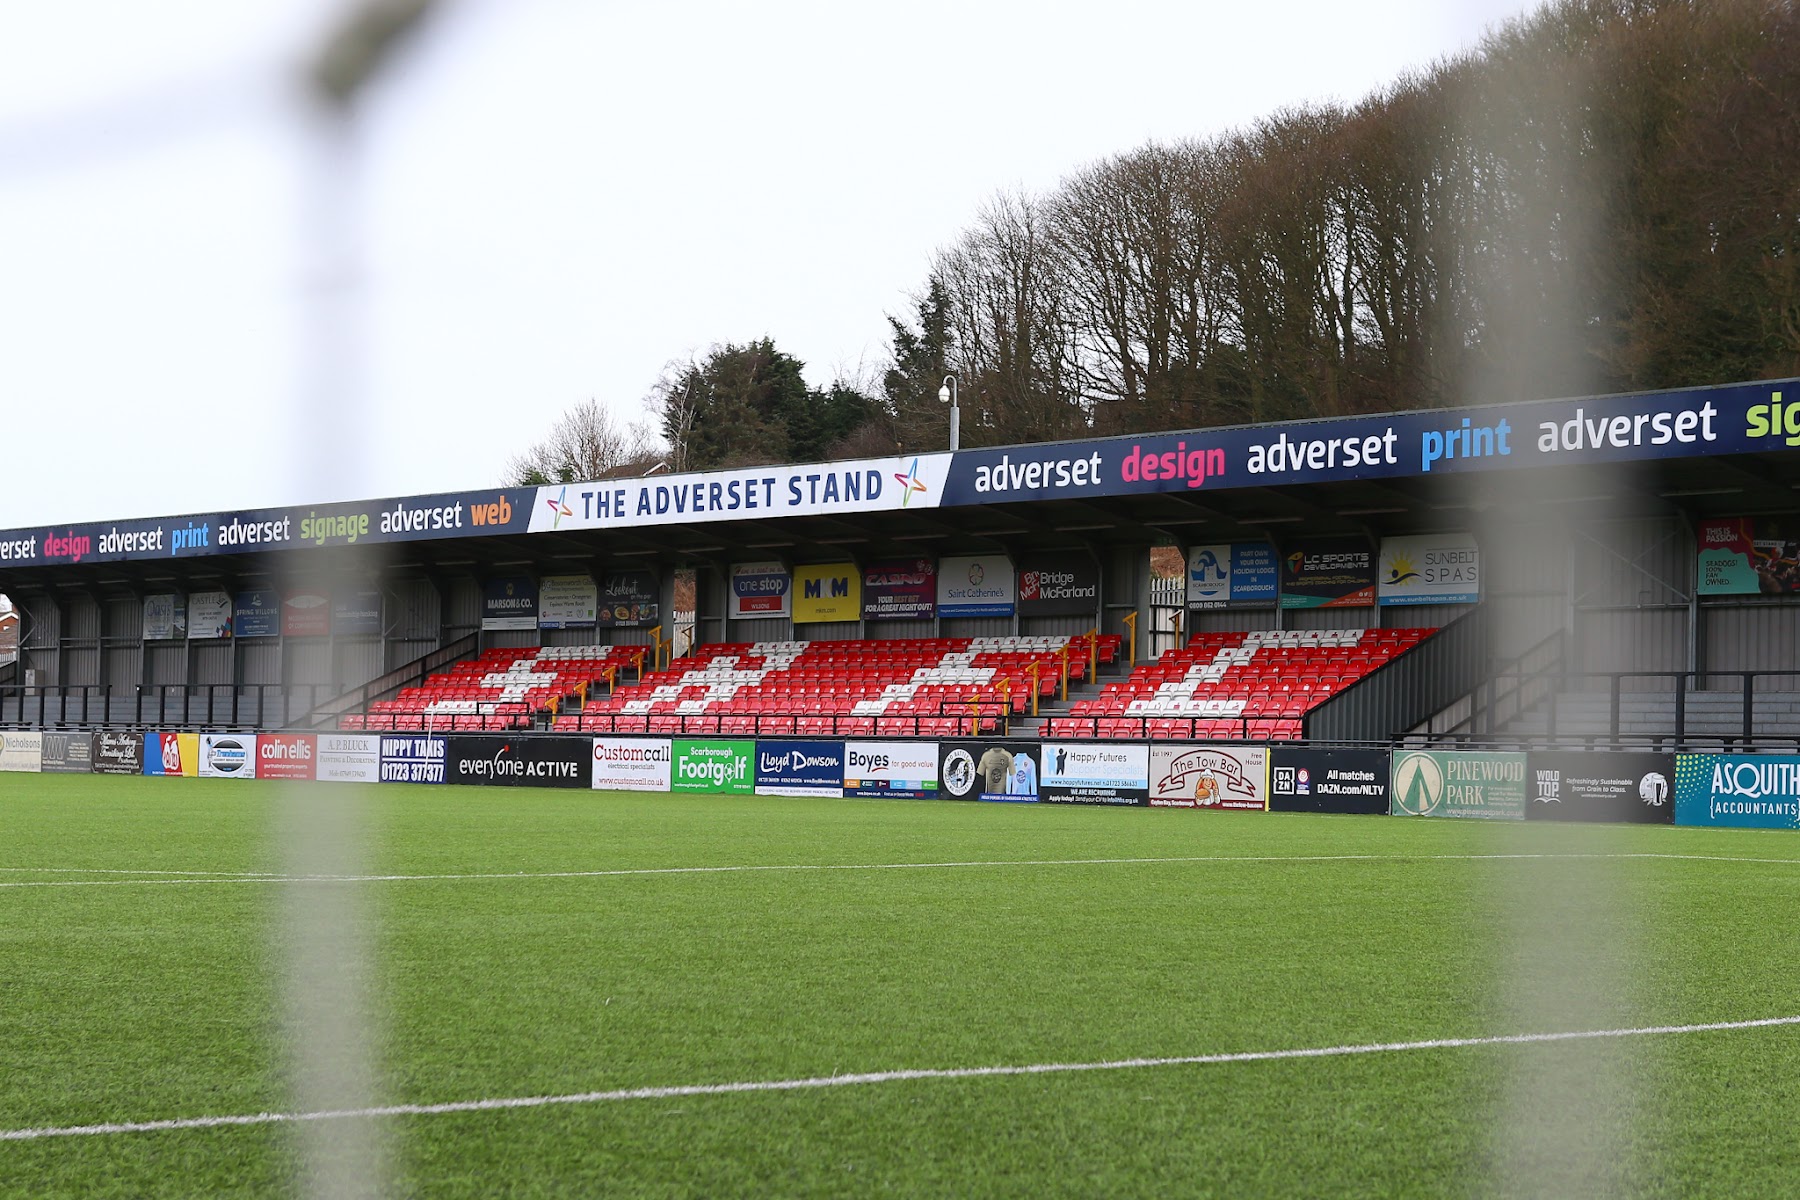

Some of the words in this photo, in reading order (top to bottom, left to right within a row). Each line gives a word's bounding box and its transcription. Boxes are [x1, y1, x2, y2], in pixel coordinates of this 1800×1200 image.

[1537, 401, 1717, 452] adverset
[974, 451, 1101, 492] adverset
[1121, 441, 1225, 488] design
[1247, 427, 1398, 473] adverset
[1421, 418, 1511, 472] print
[581, 490, 626, 519] THE
[636, 478, 776, 516] ADVERSET
[788, 470, 882, 505] STAND
[0, 535, 36, 560] erset
[44, 532, 90, 561] design
[98, 527, 163, 553] adverset
[171, 522, 209, 555] print
[218, 516, 290, 546] adverset
[300, 512, 369, 545] signage
[380, 503, 462, 533] adverset
[470, 496, 512, 526] web
[1706, 534, 1738, 542] PASSION
[1305, 555, 1319, 563] LC
[1322, 553, 1369, 562] SPORTS
[1425, 551, 1477, 565] SUNBELT
[1304, 562, 1369, 571] DEVELOPMENTS
[865, 573, 926, 586] CASINO
[1040, 572, 1074, 586] Bridge
[1425, 567, 1477, 582] SPAS
[740, 581, 757, 591] one
[760, 578, 783, 594] stop
[805, 577, 848, 598] MKM
[948, 589, 965, 598] Saint
[967, 588, 1004, 598] Catherine's
[1040, 585, 1095, 599] McFarland
[878, 596, 893, 604] YOUR
[882, 604, 899, 612] GREAT
[262, 739, 287, 759] colin
[288, 739, 311, 759] ellis
[343, 740, 369, 751] BLUCK
[382, 739, 412, 757] NIPPY
[414, 739, 444, 757] TAXIS
[594, 744, 669, 761] Customcall
[690, 746, 733, 758] Scarborough
[459, 747, 523, 779] everyone
[526, 761, 578, 777] ACTIVE
[761, 752, 790, 773] Lloyd
[792, 751, 839, 771] Dowson
[849, 751, 889, 773] Boyes
[900, 761, 915, 769] good
[1070, 752, 1097, 764] Happy
[1099, 753, 1127, 762] Futures
[1174, 760, 1194, 774] The
[1196, 756, 1217, 768] Tow
[1220, 759, 1238, 775] Bar
[381, 763, 409, 781] 01723
[411, 763, 444, 782] 377377
[679, 756, 747, 785] Footgolf
[1069, 765, 1100, 776] Support
[1102, 765, 1144, 776] Specialists
[1327, 770, 1338, 780] All
[1339, 771, 1375, 781] matches
[1447, 760, 1524, 782] PINEWOOD
[1536, 770, 1560, 781] WOLD
[599, 777, 664, 786] www.customcall.co.uk
[1566, 778, 1599, 786] Refreshingly
[1600, 778, 1633, 786] Sustainable
[1711, 763, 1800, 798] ASQUITH
[1317, 783, 1385, 796] DAZN.com/NLTV
[1447, 785, 1484, 805] PARK
[1537, 782, 1560, 798] TOP.
